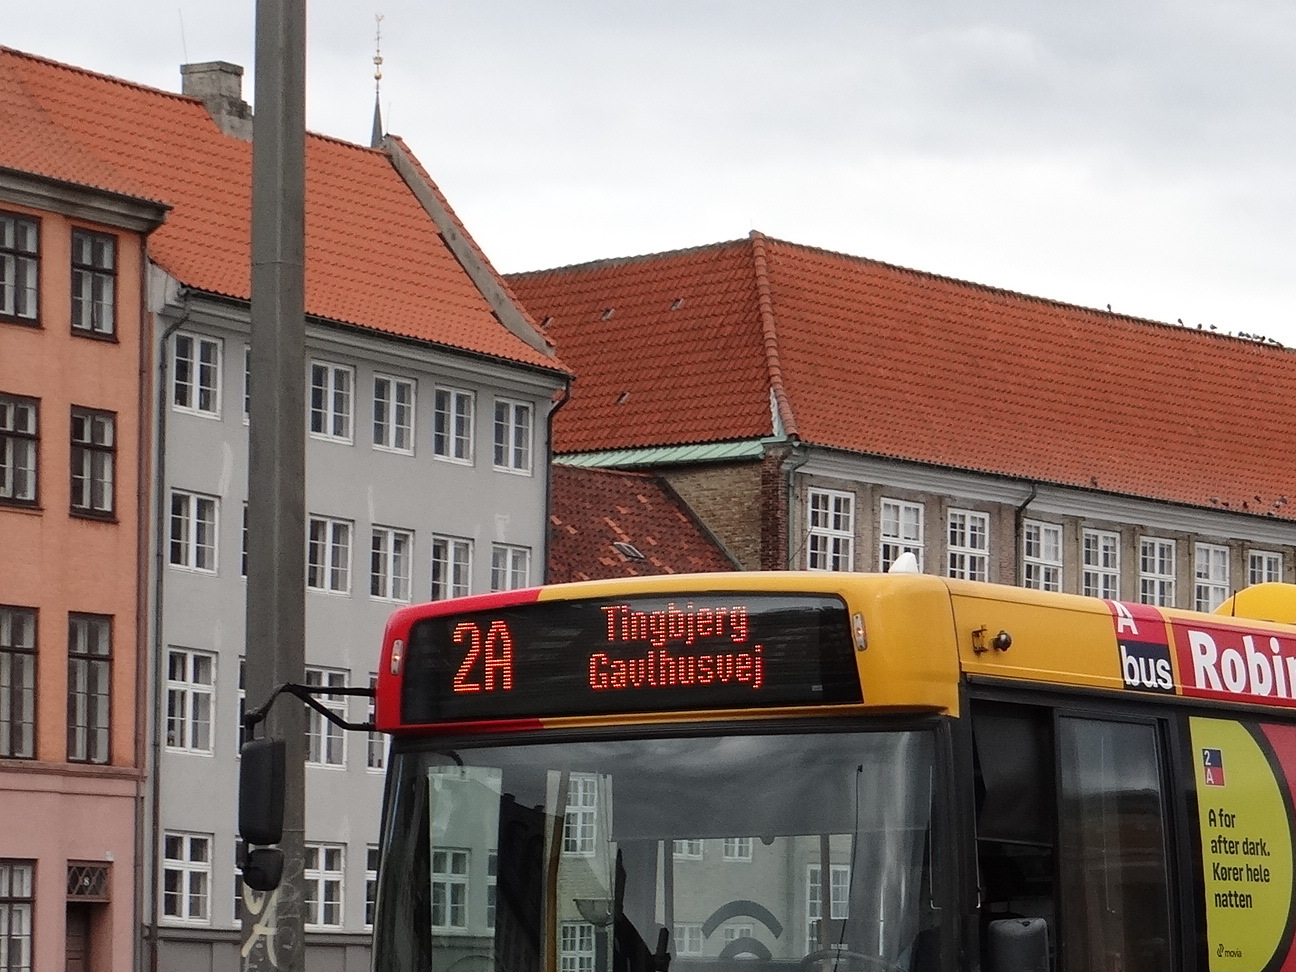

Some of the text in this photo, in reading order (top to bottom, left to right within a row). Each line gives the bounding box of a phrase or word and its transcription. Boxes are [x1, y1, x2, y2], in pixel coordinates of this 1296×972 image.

[600, 602, 748, 647] Tingbjerg
[1110, 600, 1139, 636] A
[452, 620, 514, 692] 2A
[588, 643, 764, 690] Gavlhusvej
[1120, 645, 1174, 690] bus
[1204, 750, 1212, 766] 2
[1206, 768, 1215, 785] A
[1208, 808, 1236, 828] A for
[1211, 835, 1271, 857] after dark.
[1212, 862, 1271, 883] Kører hele
[1214, 890, 1253, 909] natten
[1225, 948, 1243, 958] movia
